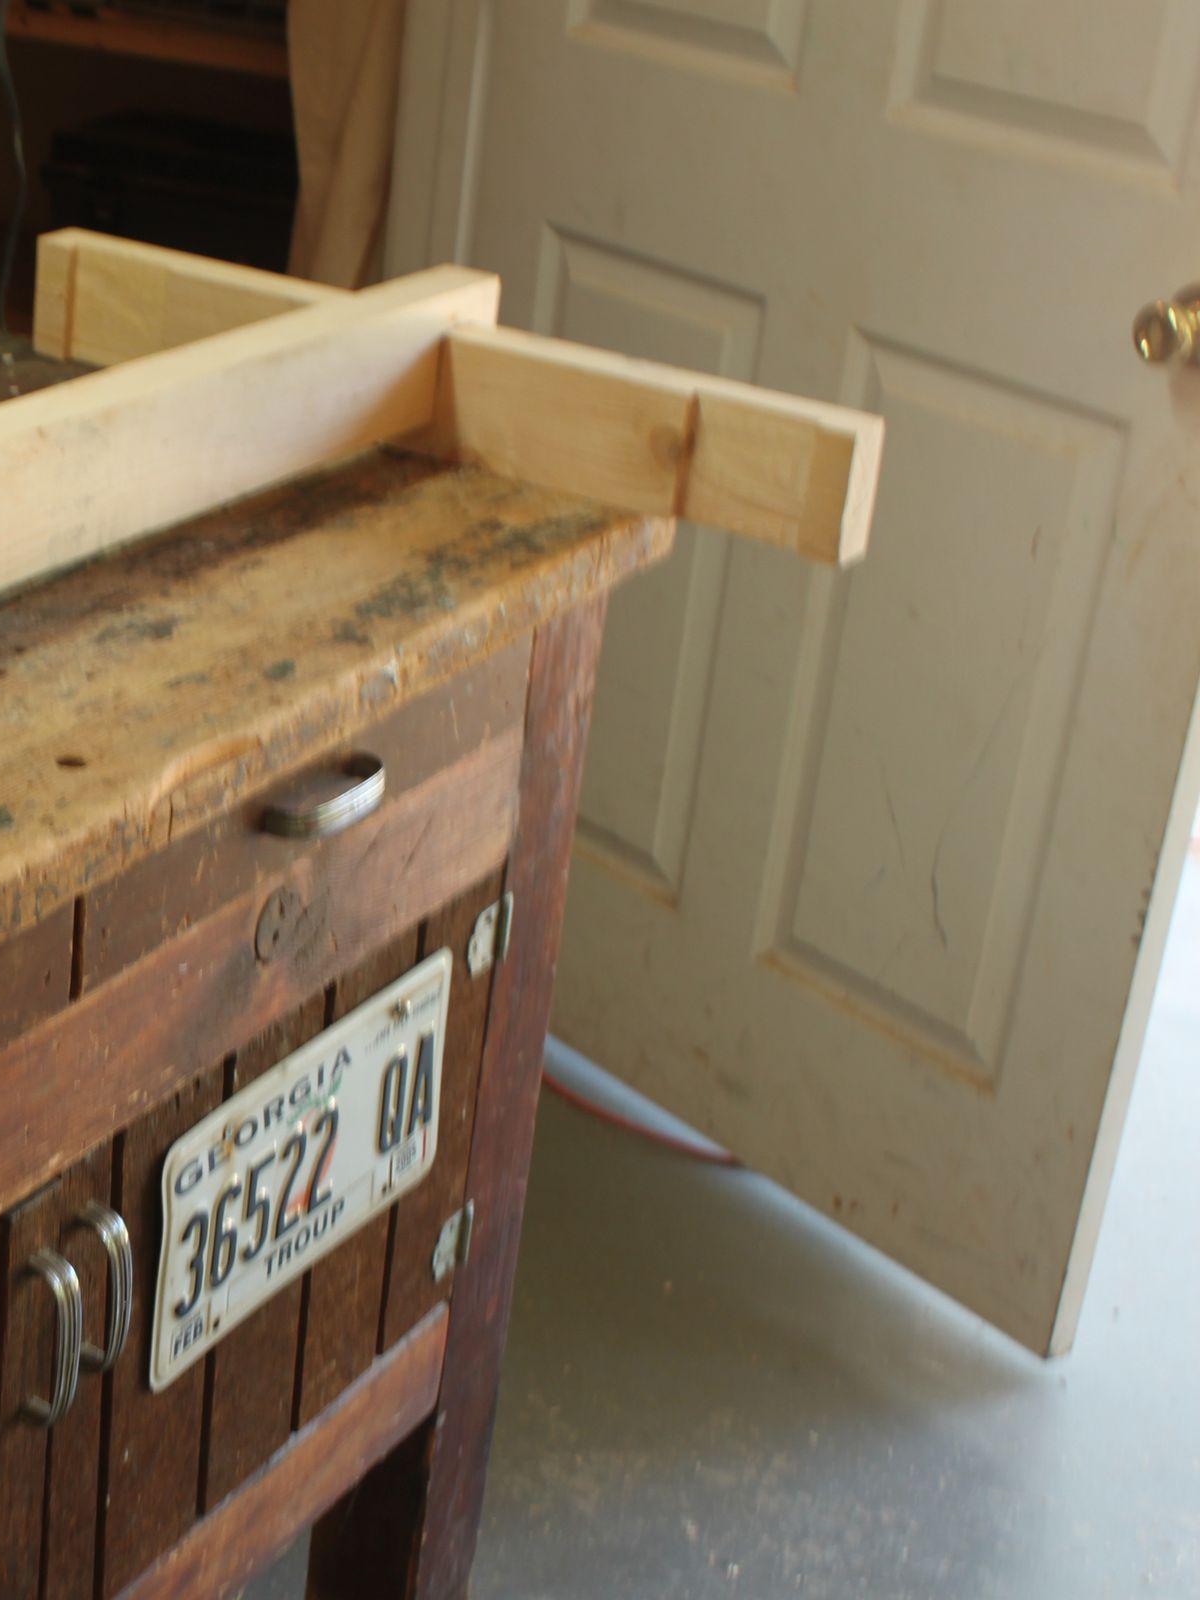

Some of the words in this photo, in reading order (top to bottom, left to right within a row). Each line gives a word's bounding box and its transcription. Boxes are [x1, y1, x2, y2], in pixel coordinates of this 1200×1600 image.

[173, 1108, 339, 1318] 36522
[378, 1032, 433, 1153] QA
[174, 1048, 351, 1195] GEORGIA
[265, 1198, 345, 1280] TROUP
[173, 1316, 203, 1359] FEB
